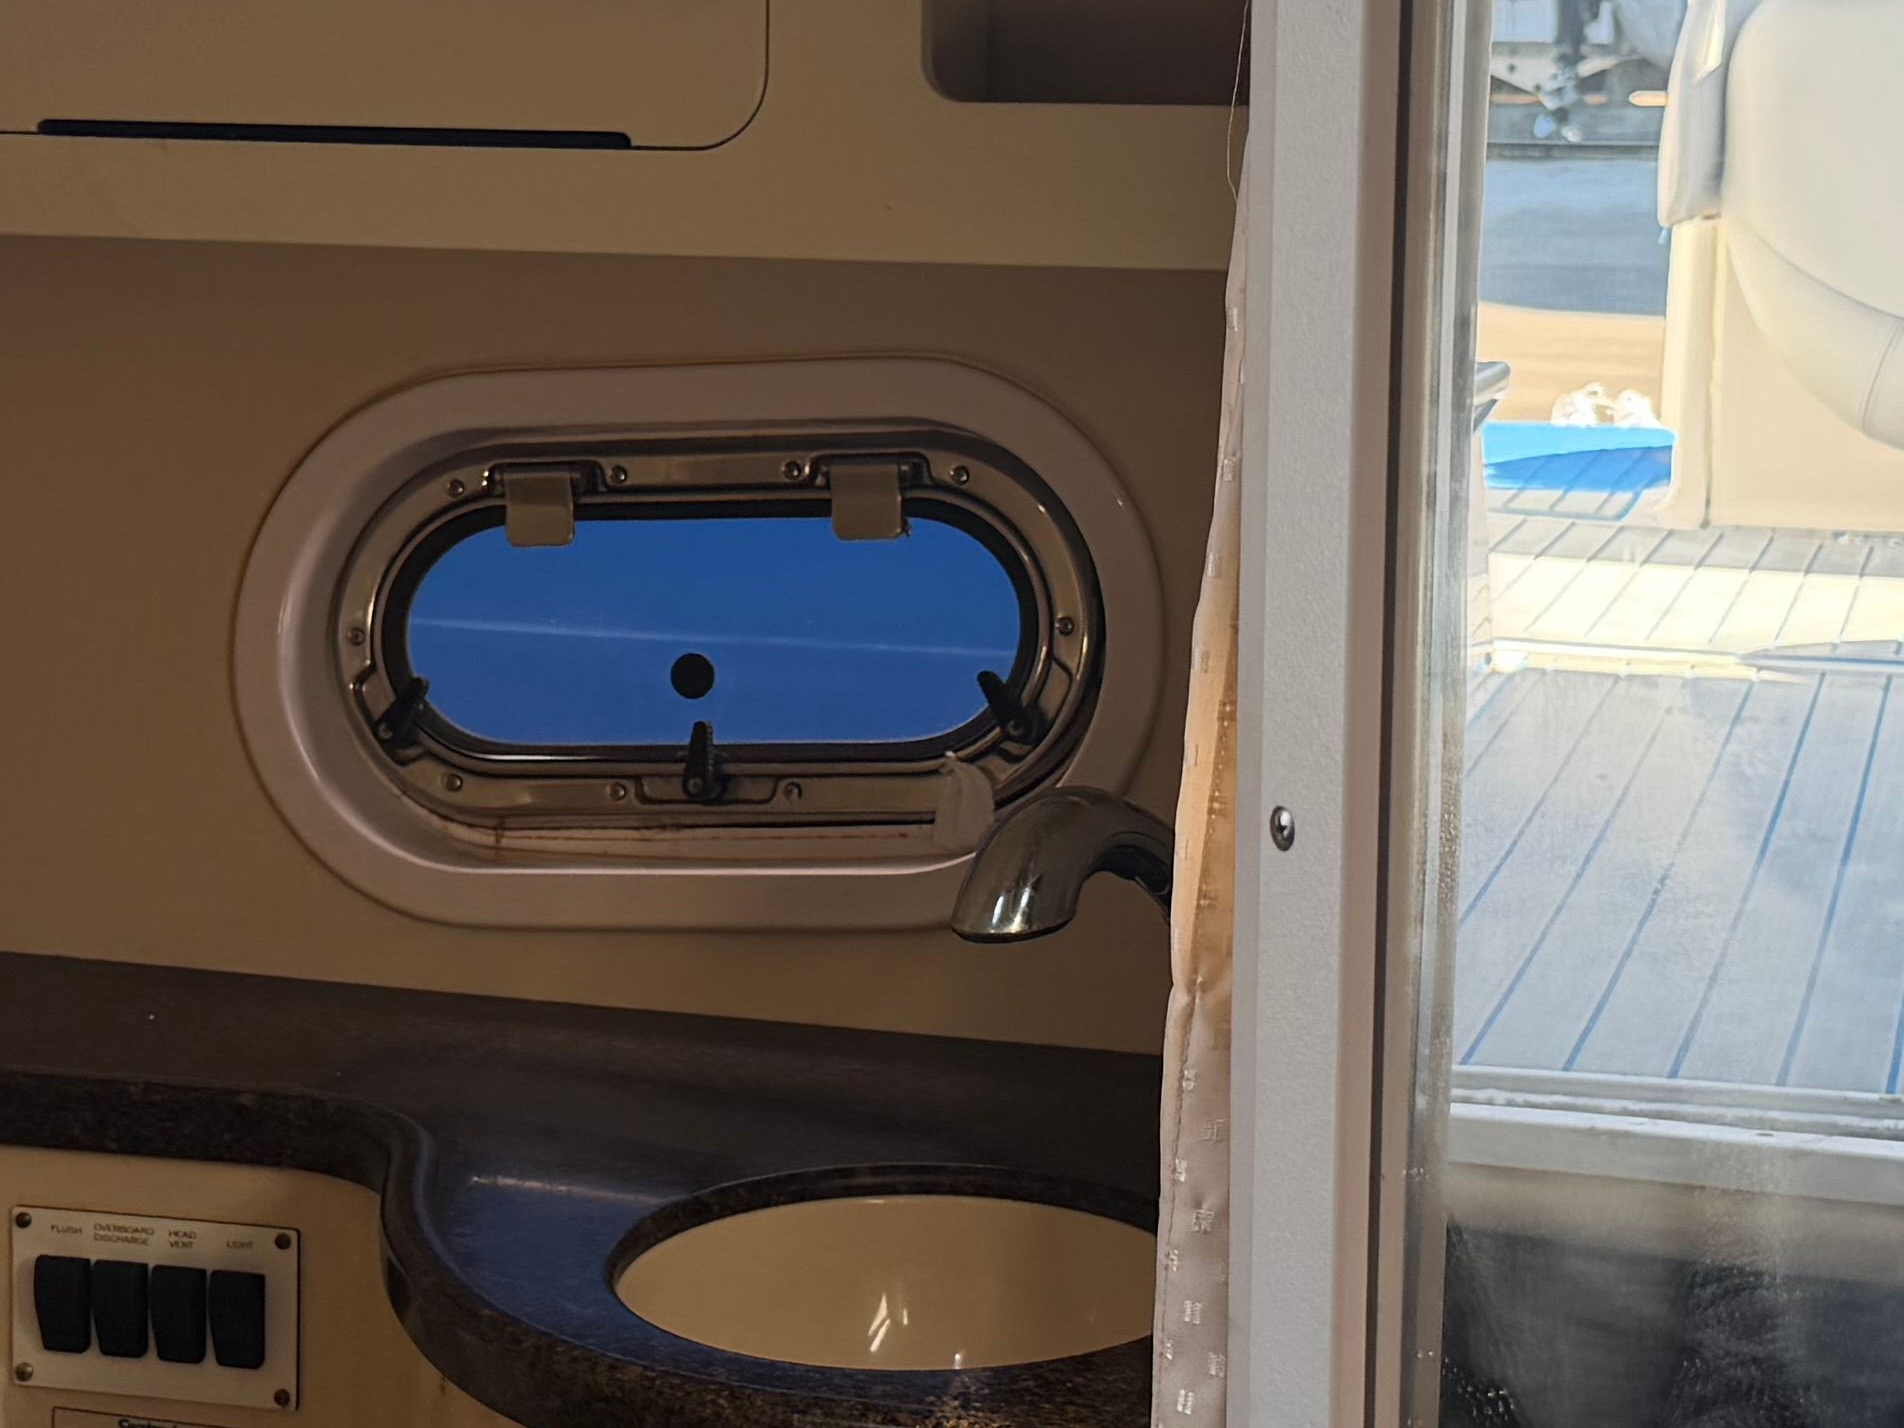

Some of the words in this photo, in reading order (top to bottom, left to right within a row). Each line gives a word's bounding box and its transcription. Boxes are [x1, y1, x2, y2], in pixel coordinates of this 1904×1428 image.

[50, 1224, 83, 1235] FLUSH
[168, 1229, 197, 1240] HEAD
[168, 1239, 195, 1250] VENT
[226, 1239, 254, 1250] LIGHT
